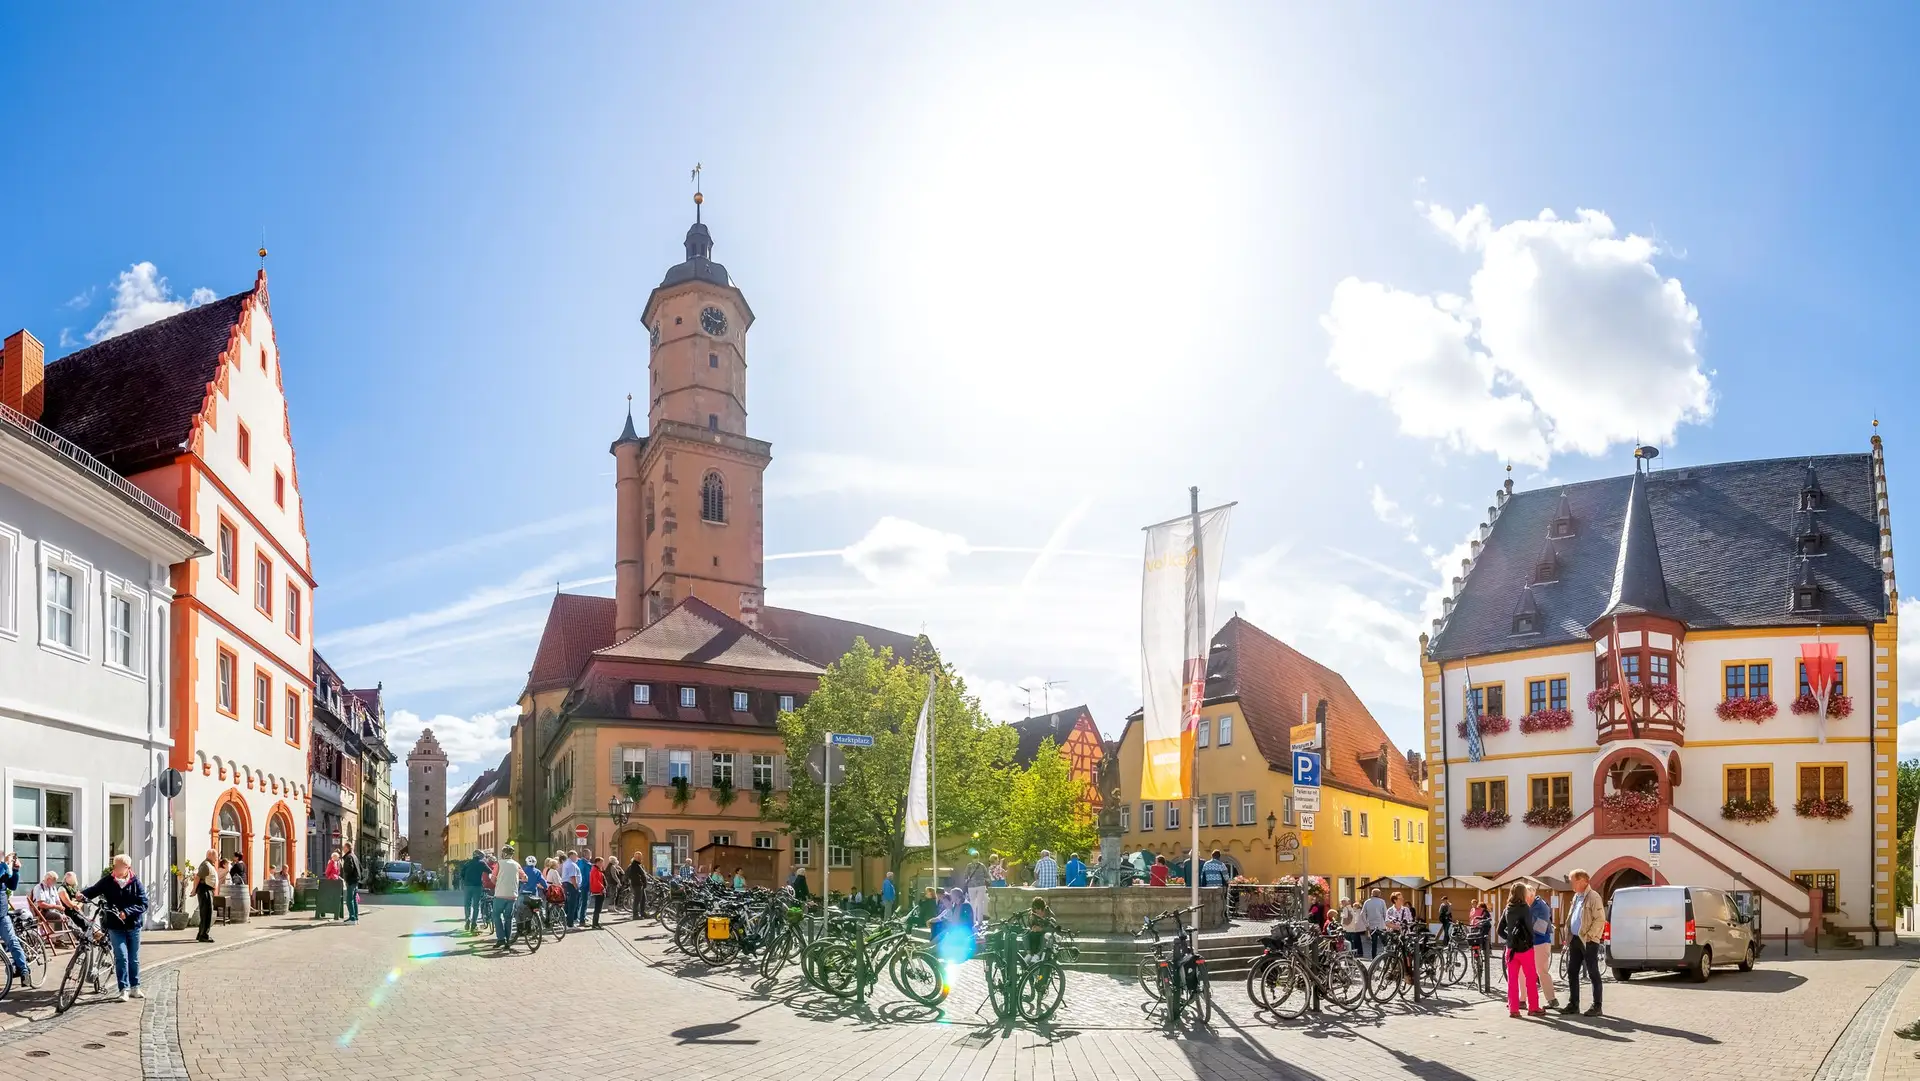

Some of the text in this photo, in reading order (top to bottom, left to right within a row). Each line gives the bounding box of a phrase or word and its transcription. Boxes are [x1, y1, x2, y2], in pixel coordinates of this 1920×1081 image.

[835, 736, 870, 744] Marktplatz
[1298, 756, 1312, 781] P
[1302, 816, 1313, 825] WC
[1651, 838, 1658, 851] P
